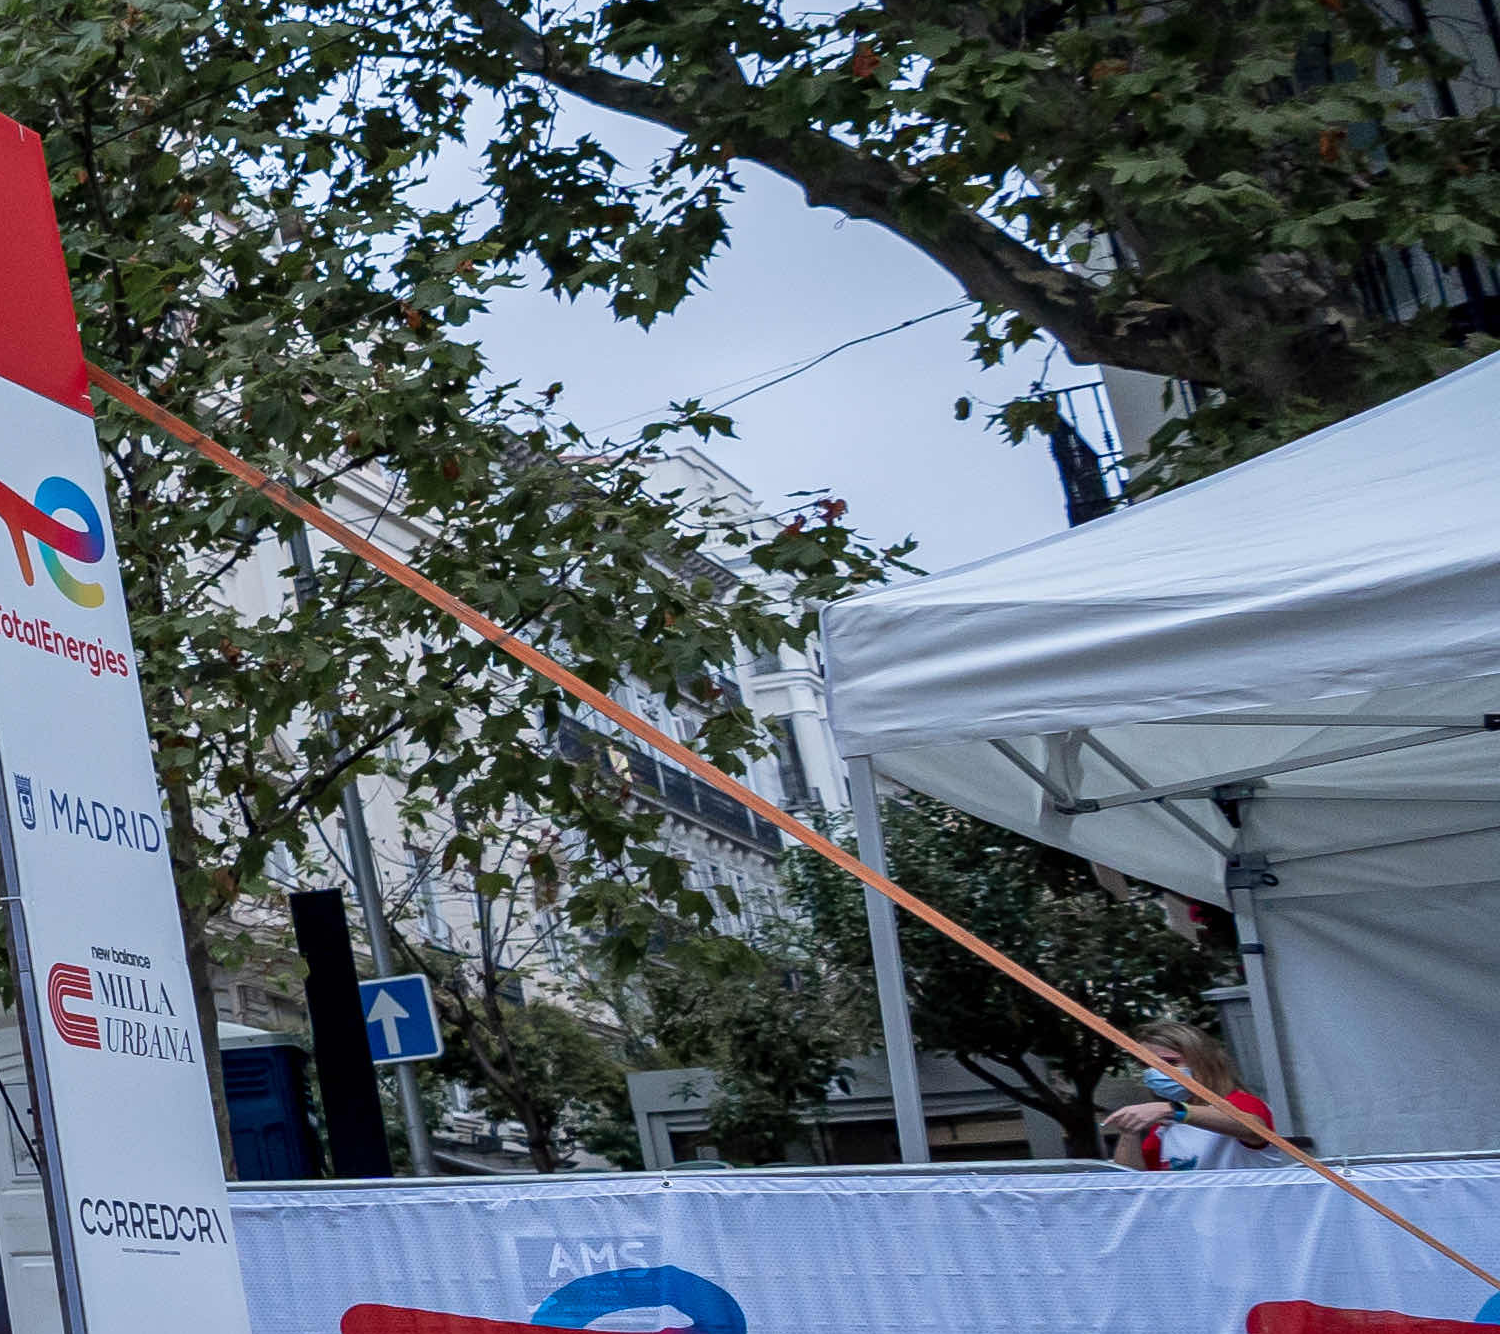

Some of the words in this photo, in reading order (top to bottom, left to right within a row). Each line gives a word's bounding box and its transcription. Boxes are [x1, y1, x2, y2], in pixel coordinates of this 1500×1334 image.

[49, 788, 161, 854] MADRID
[91, 945, 111, 962] new
[112, 948, 151, 970] balance
[95, 970, 178, 1018] MILLA
[104, 1016, 196, 1064] URBANA
